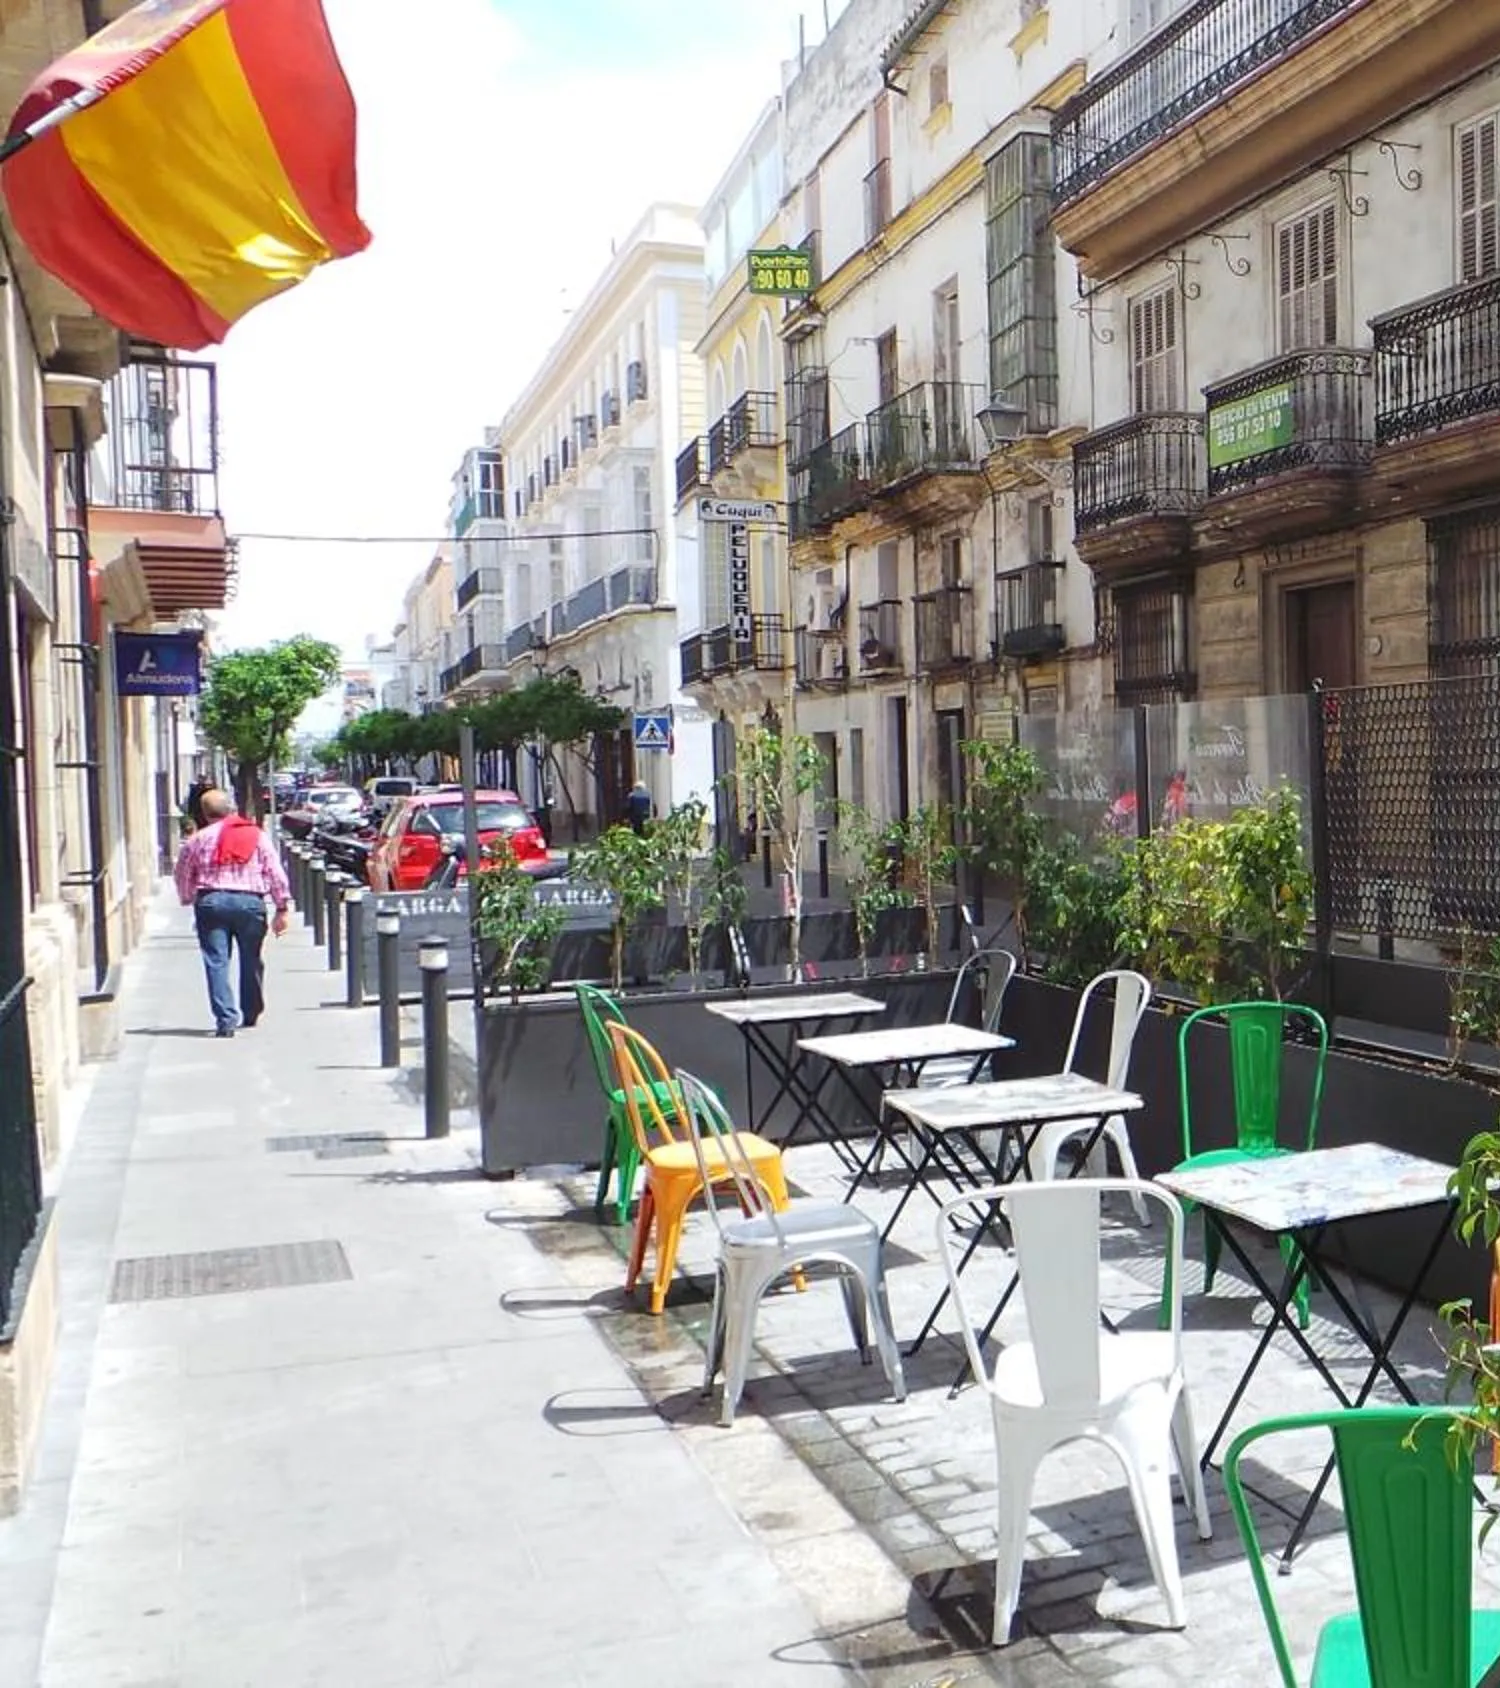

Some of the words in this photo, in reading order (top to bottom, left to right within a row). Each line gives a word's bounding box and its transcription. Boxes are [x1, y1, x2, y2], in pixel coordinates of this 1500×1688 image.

[1259, 388, 1290, 413] VENTA
[715, 503, 762, 519] Cuqui
[533, 887, 612, 906] LARGA
[377, 897, 461, 916] LARGA
